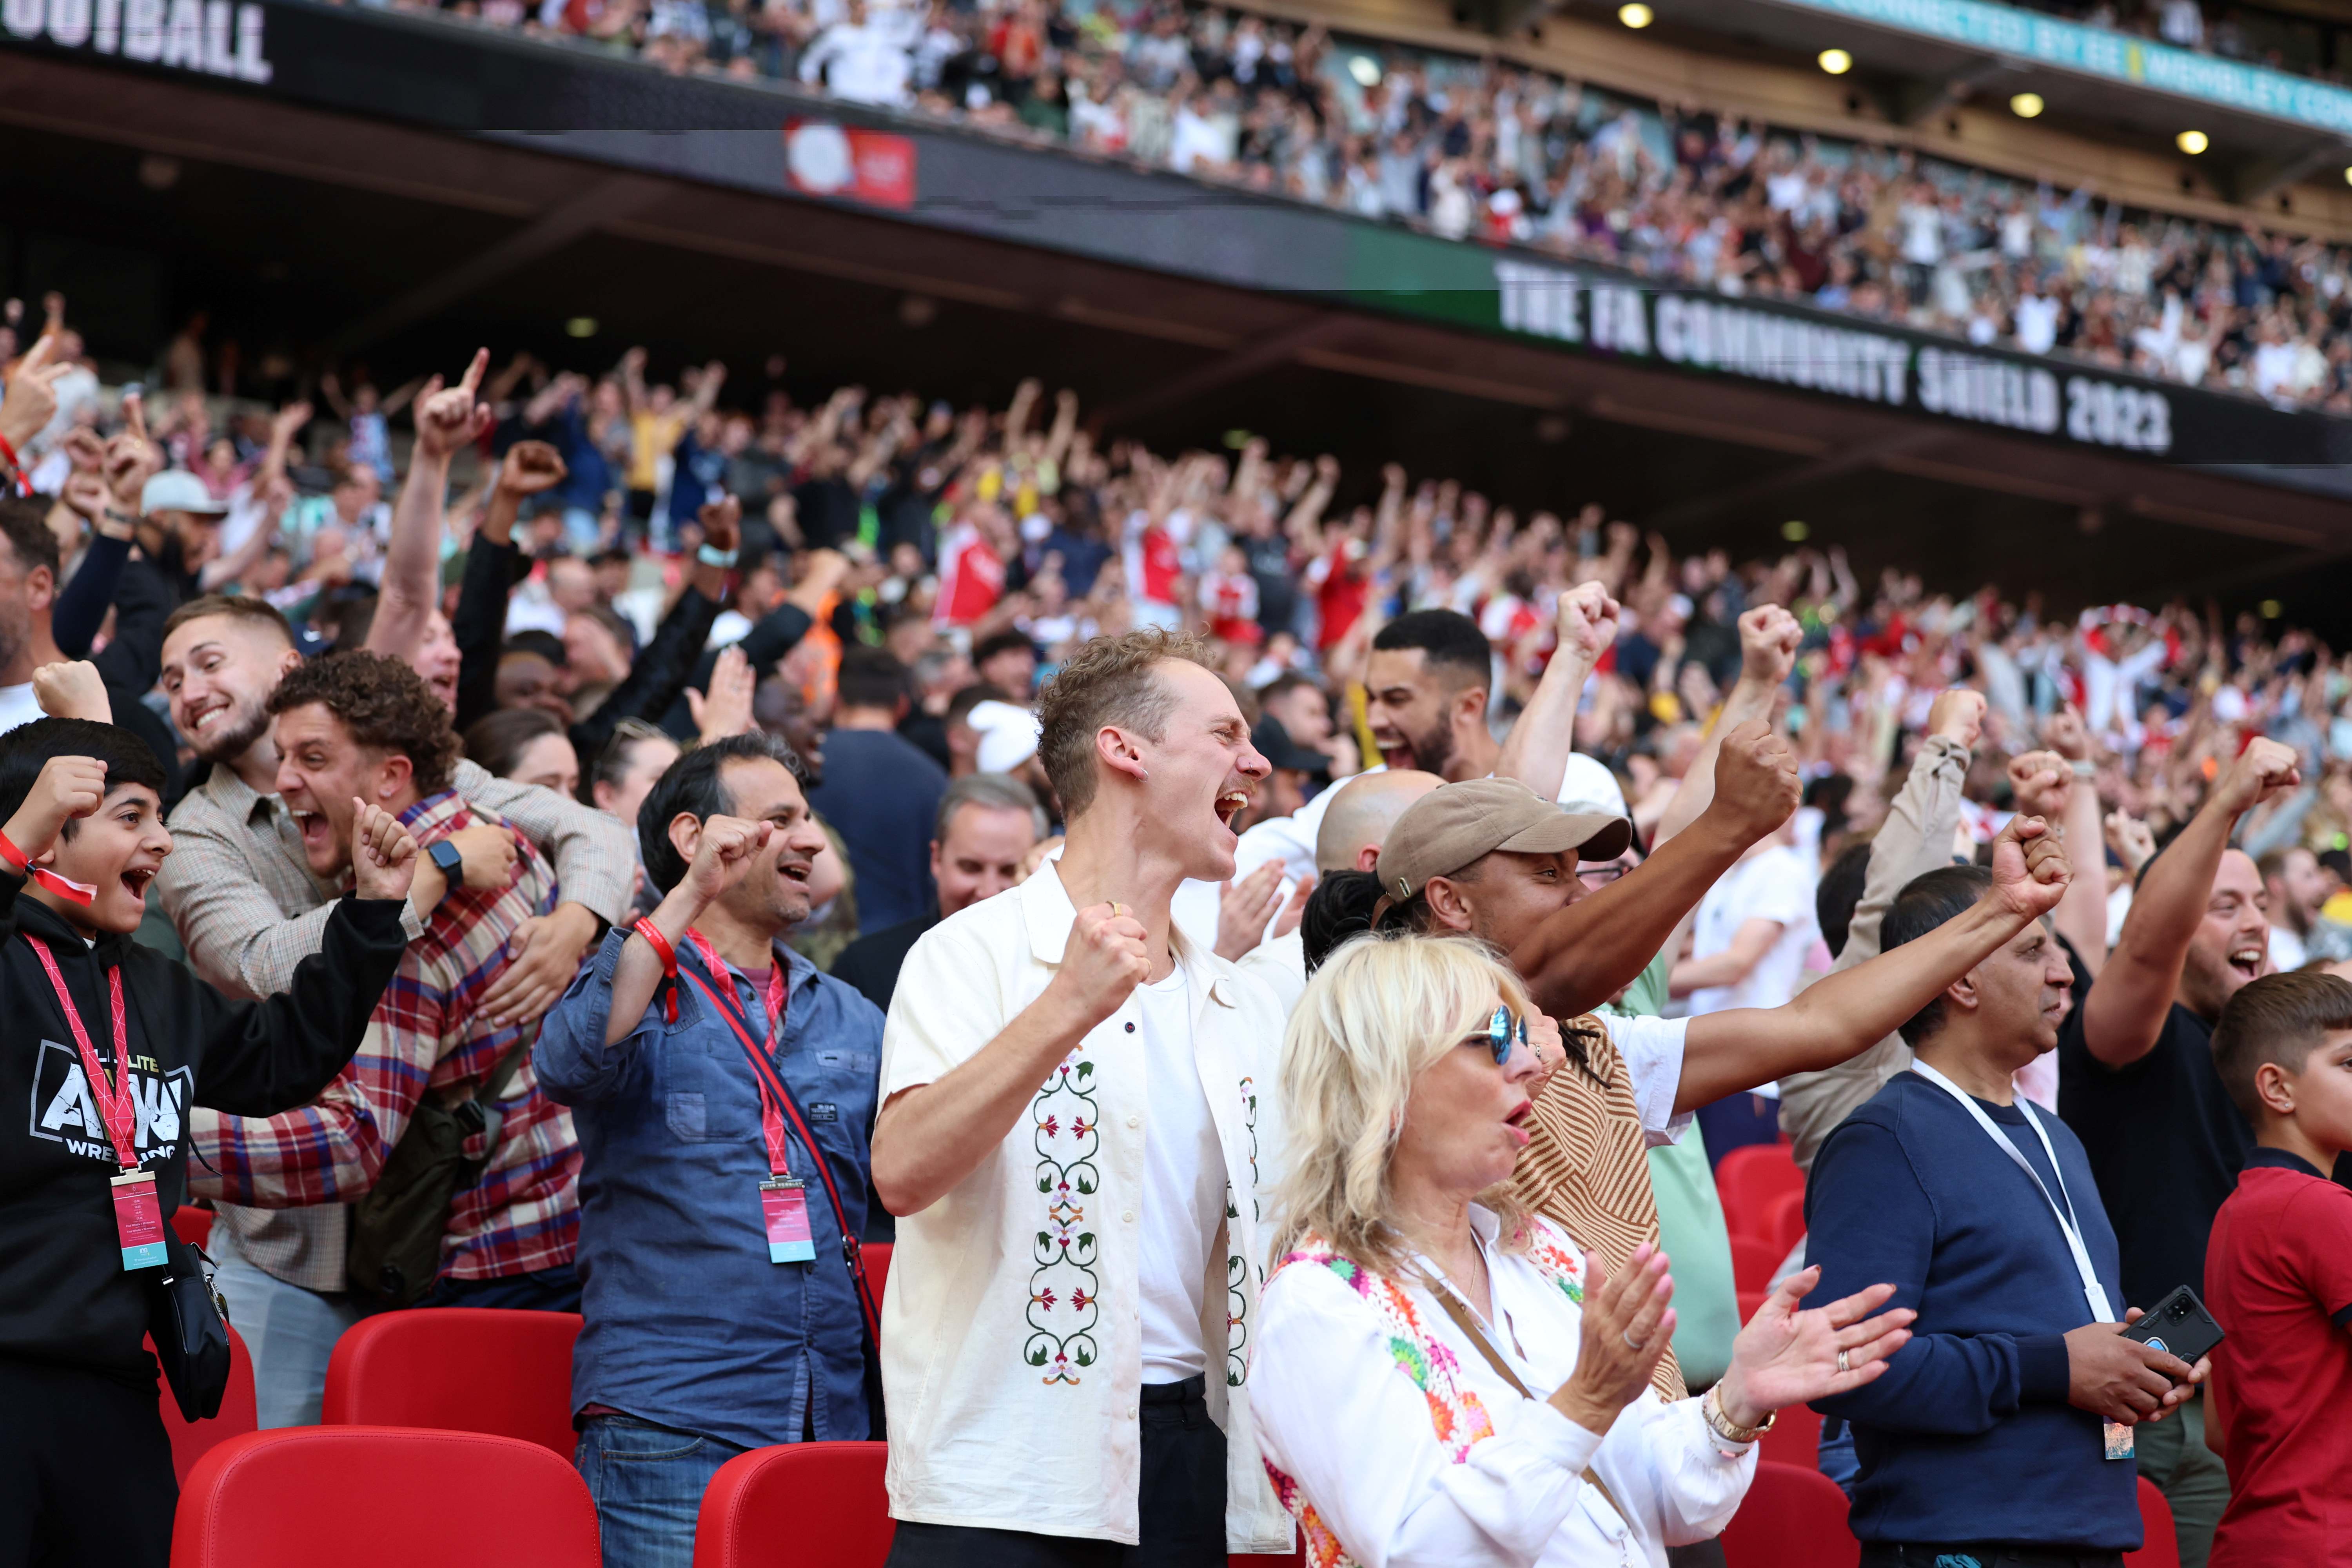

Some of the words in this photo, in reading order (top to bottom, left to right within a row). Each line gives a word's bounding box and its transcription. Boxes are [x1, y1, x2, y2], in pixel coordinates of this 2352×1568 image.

[1494, 261, 1584, 344] THE
[1590, 281, 1649, 356] FA
[1654, 295, 1910, 406] COMMUNITY
[1917, 346, 2060, 434] SHIELD
[2065, 375, 2171, 457] 2023
[40, 1062, 181, 1148] AW
[127, 1054, 159, 1073] LITE
